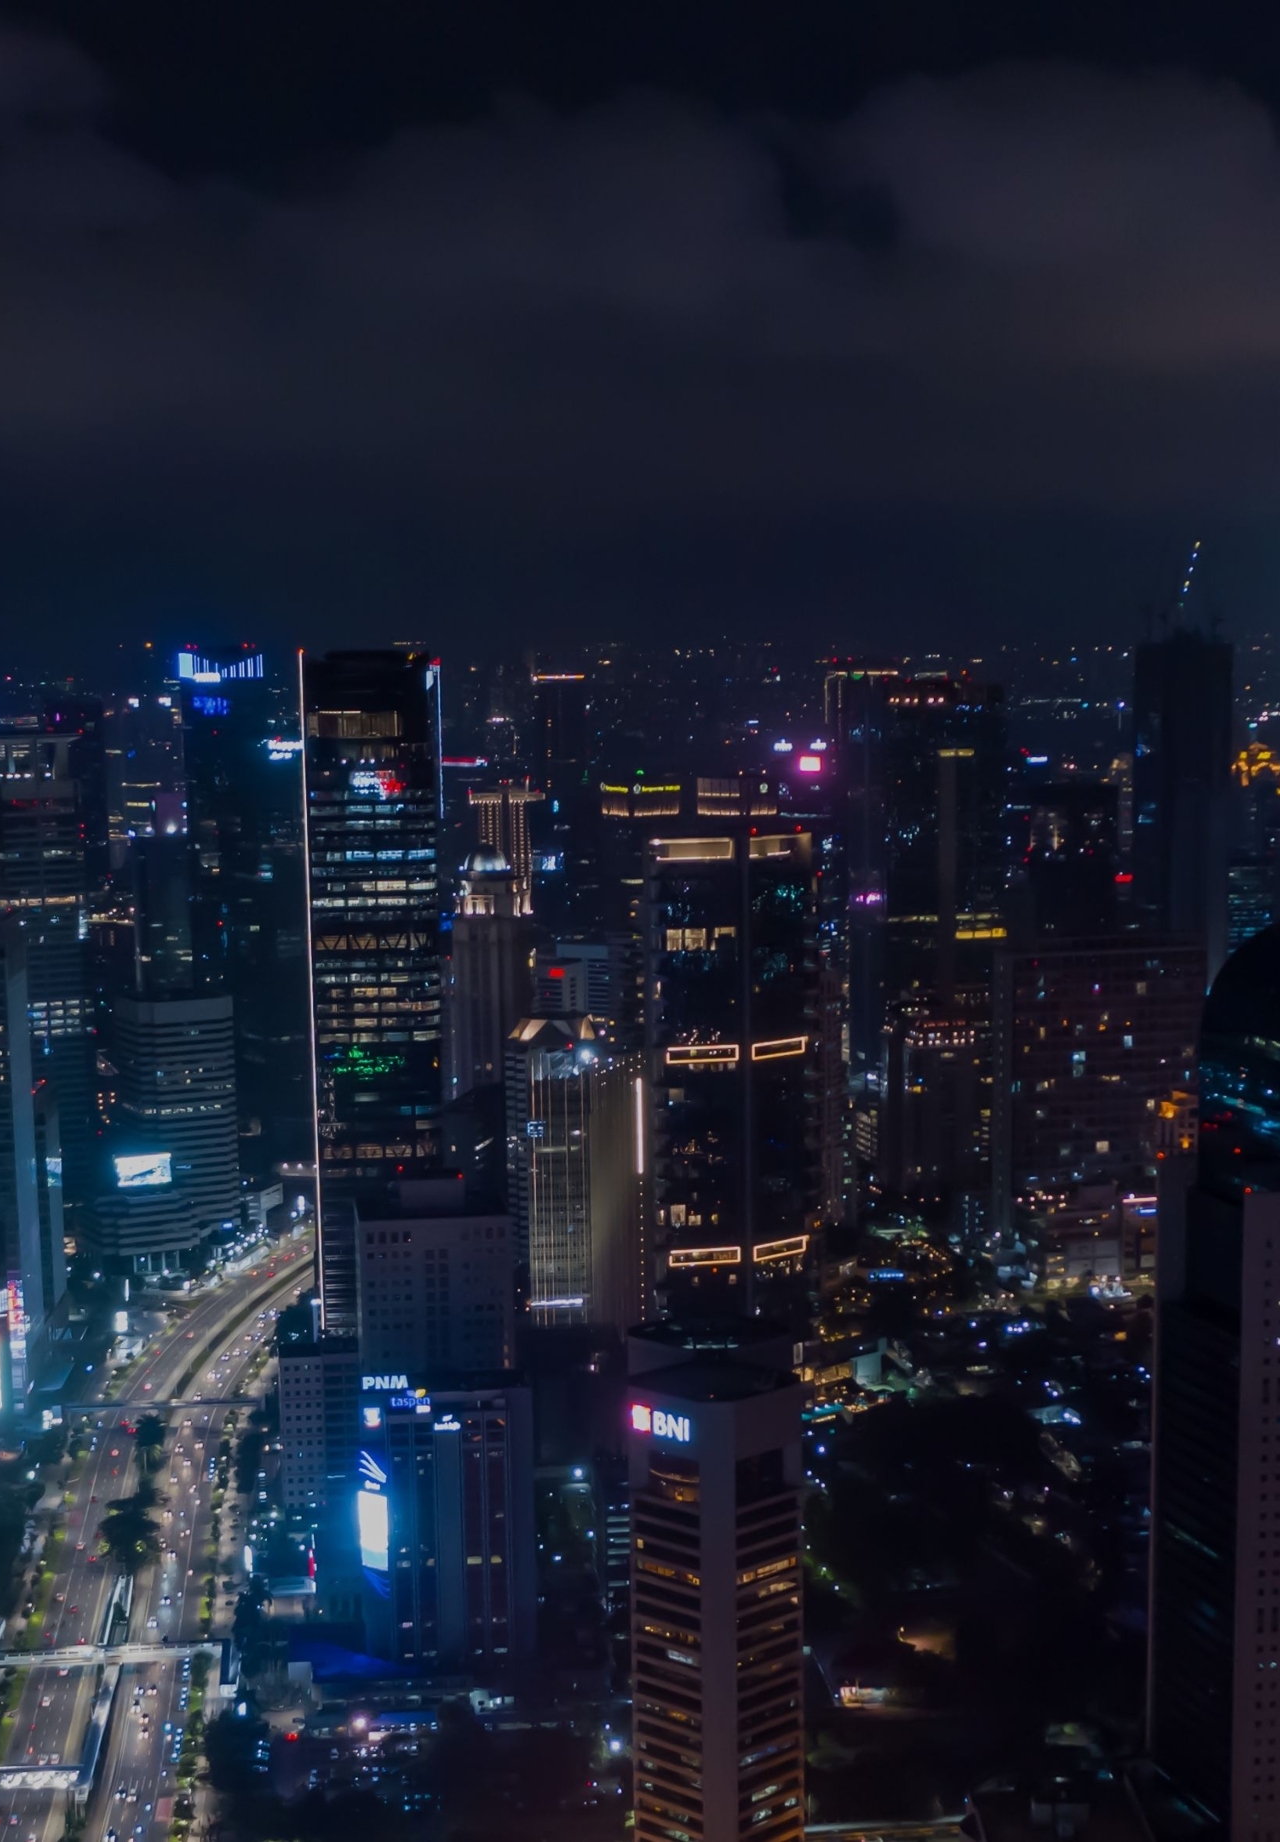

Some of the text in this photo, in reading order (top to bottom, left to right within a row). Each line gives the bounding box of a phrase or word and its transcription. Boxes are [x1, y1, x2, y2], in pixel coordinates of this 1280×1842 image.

[362, 1375, 409, 1390] PNM
[391, 1397, 431, 1408] taspen
[653, 1410, 690, 1442] BNI
